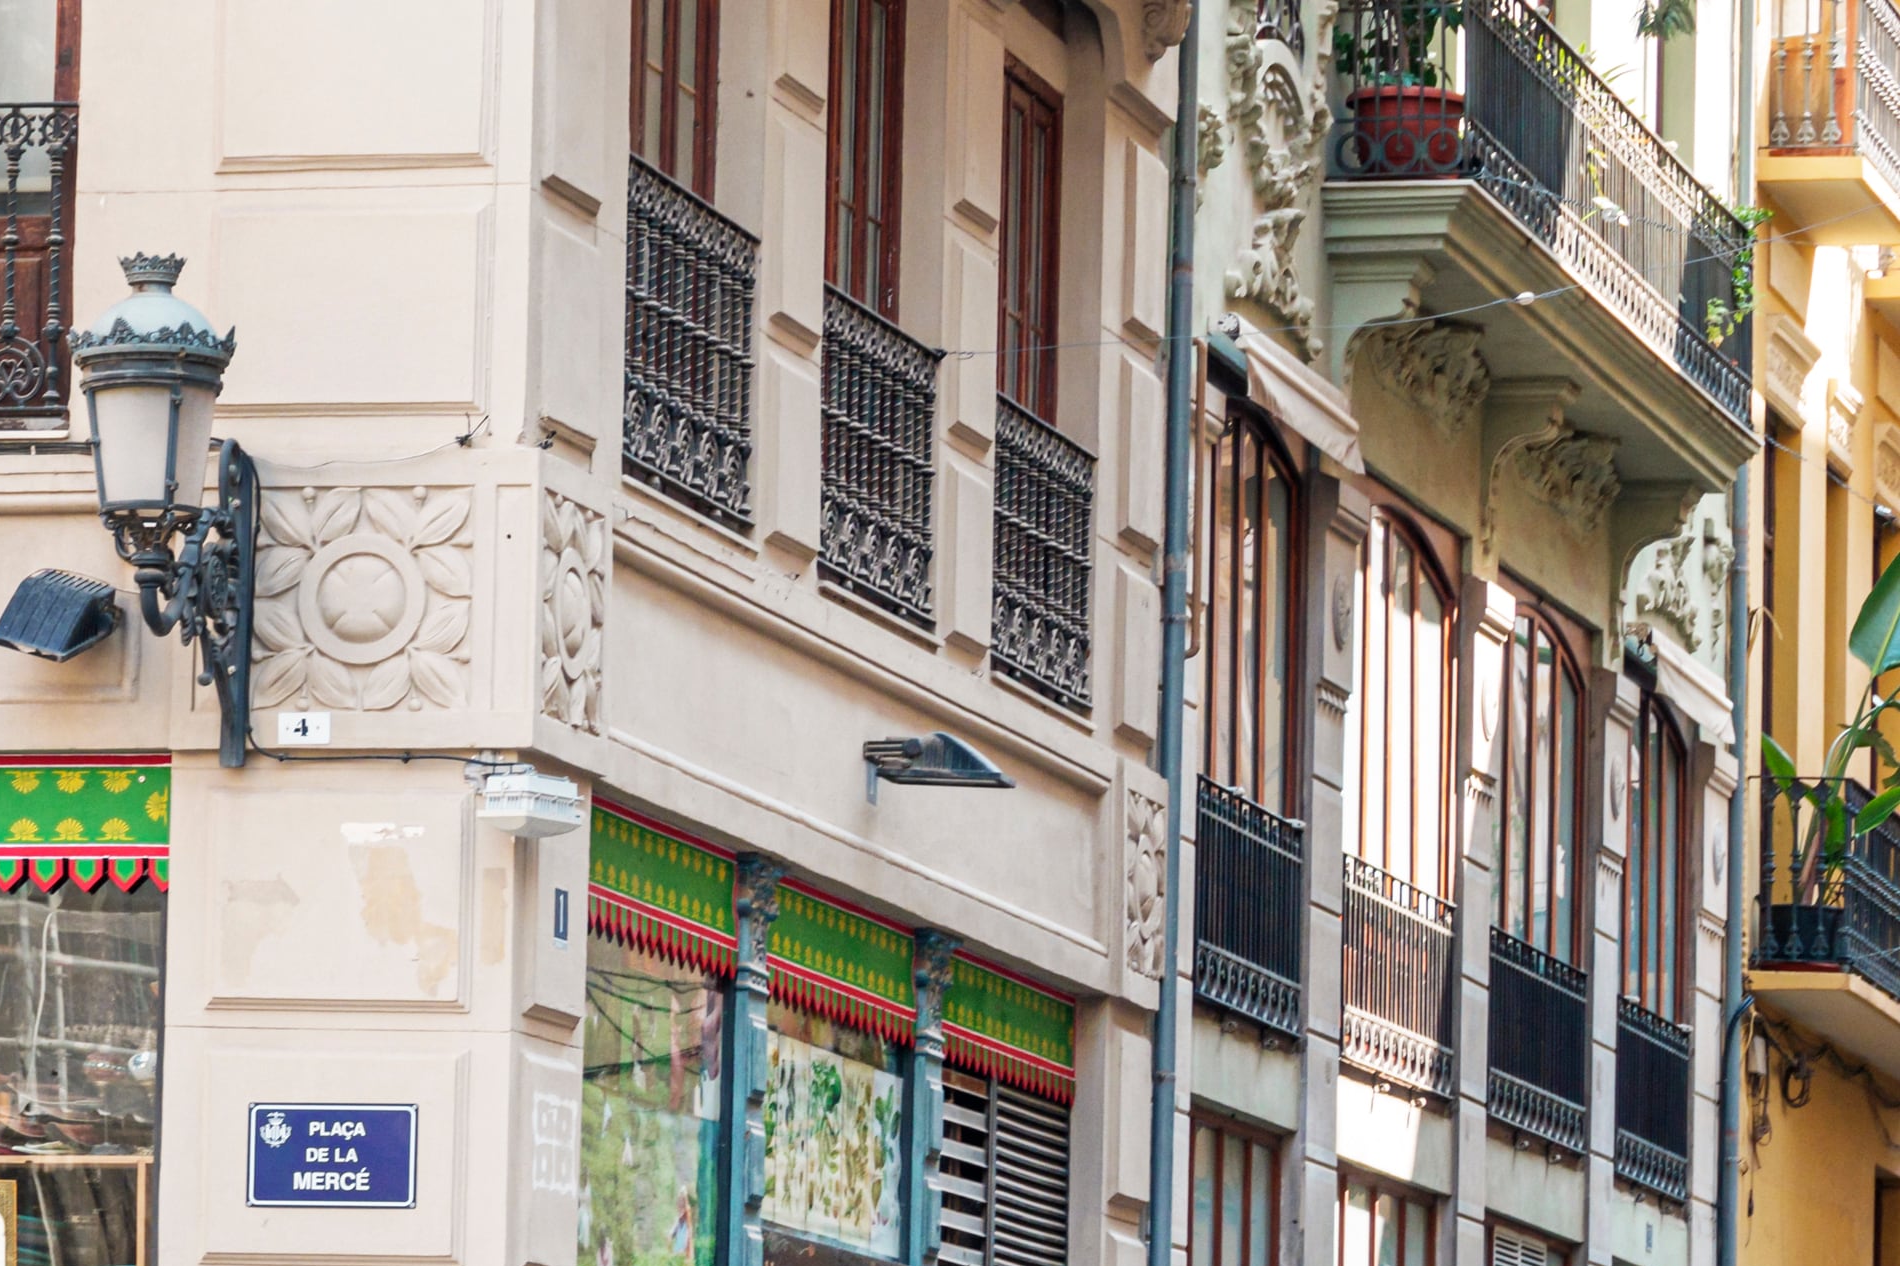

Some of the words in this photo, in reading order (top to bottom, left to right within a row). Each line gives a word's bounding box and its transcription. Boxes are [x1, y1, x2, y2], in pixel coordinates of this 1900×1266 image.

[293, 718, 309, 737] 4
[309, 1121, 366, 1140] PLAÇA
[305, 1148, 329, 1162] DE
[334, 1148, 358, 1162] LA
[292, 1167, 370, 1190] MERCÉ
